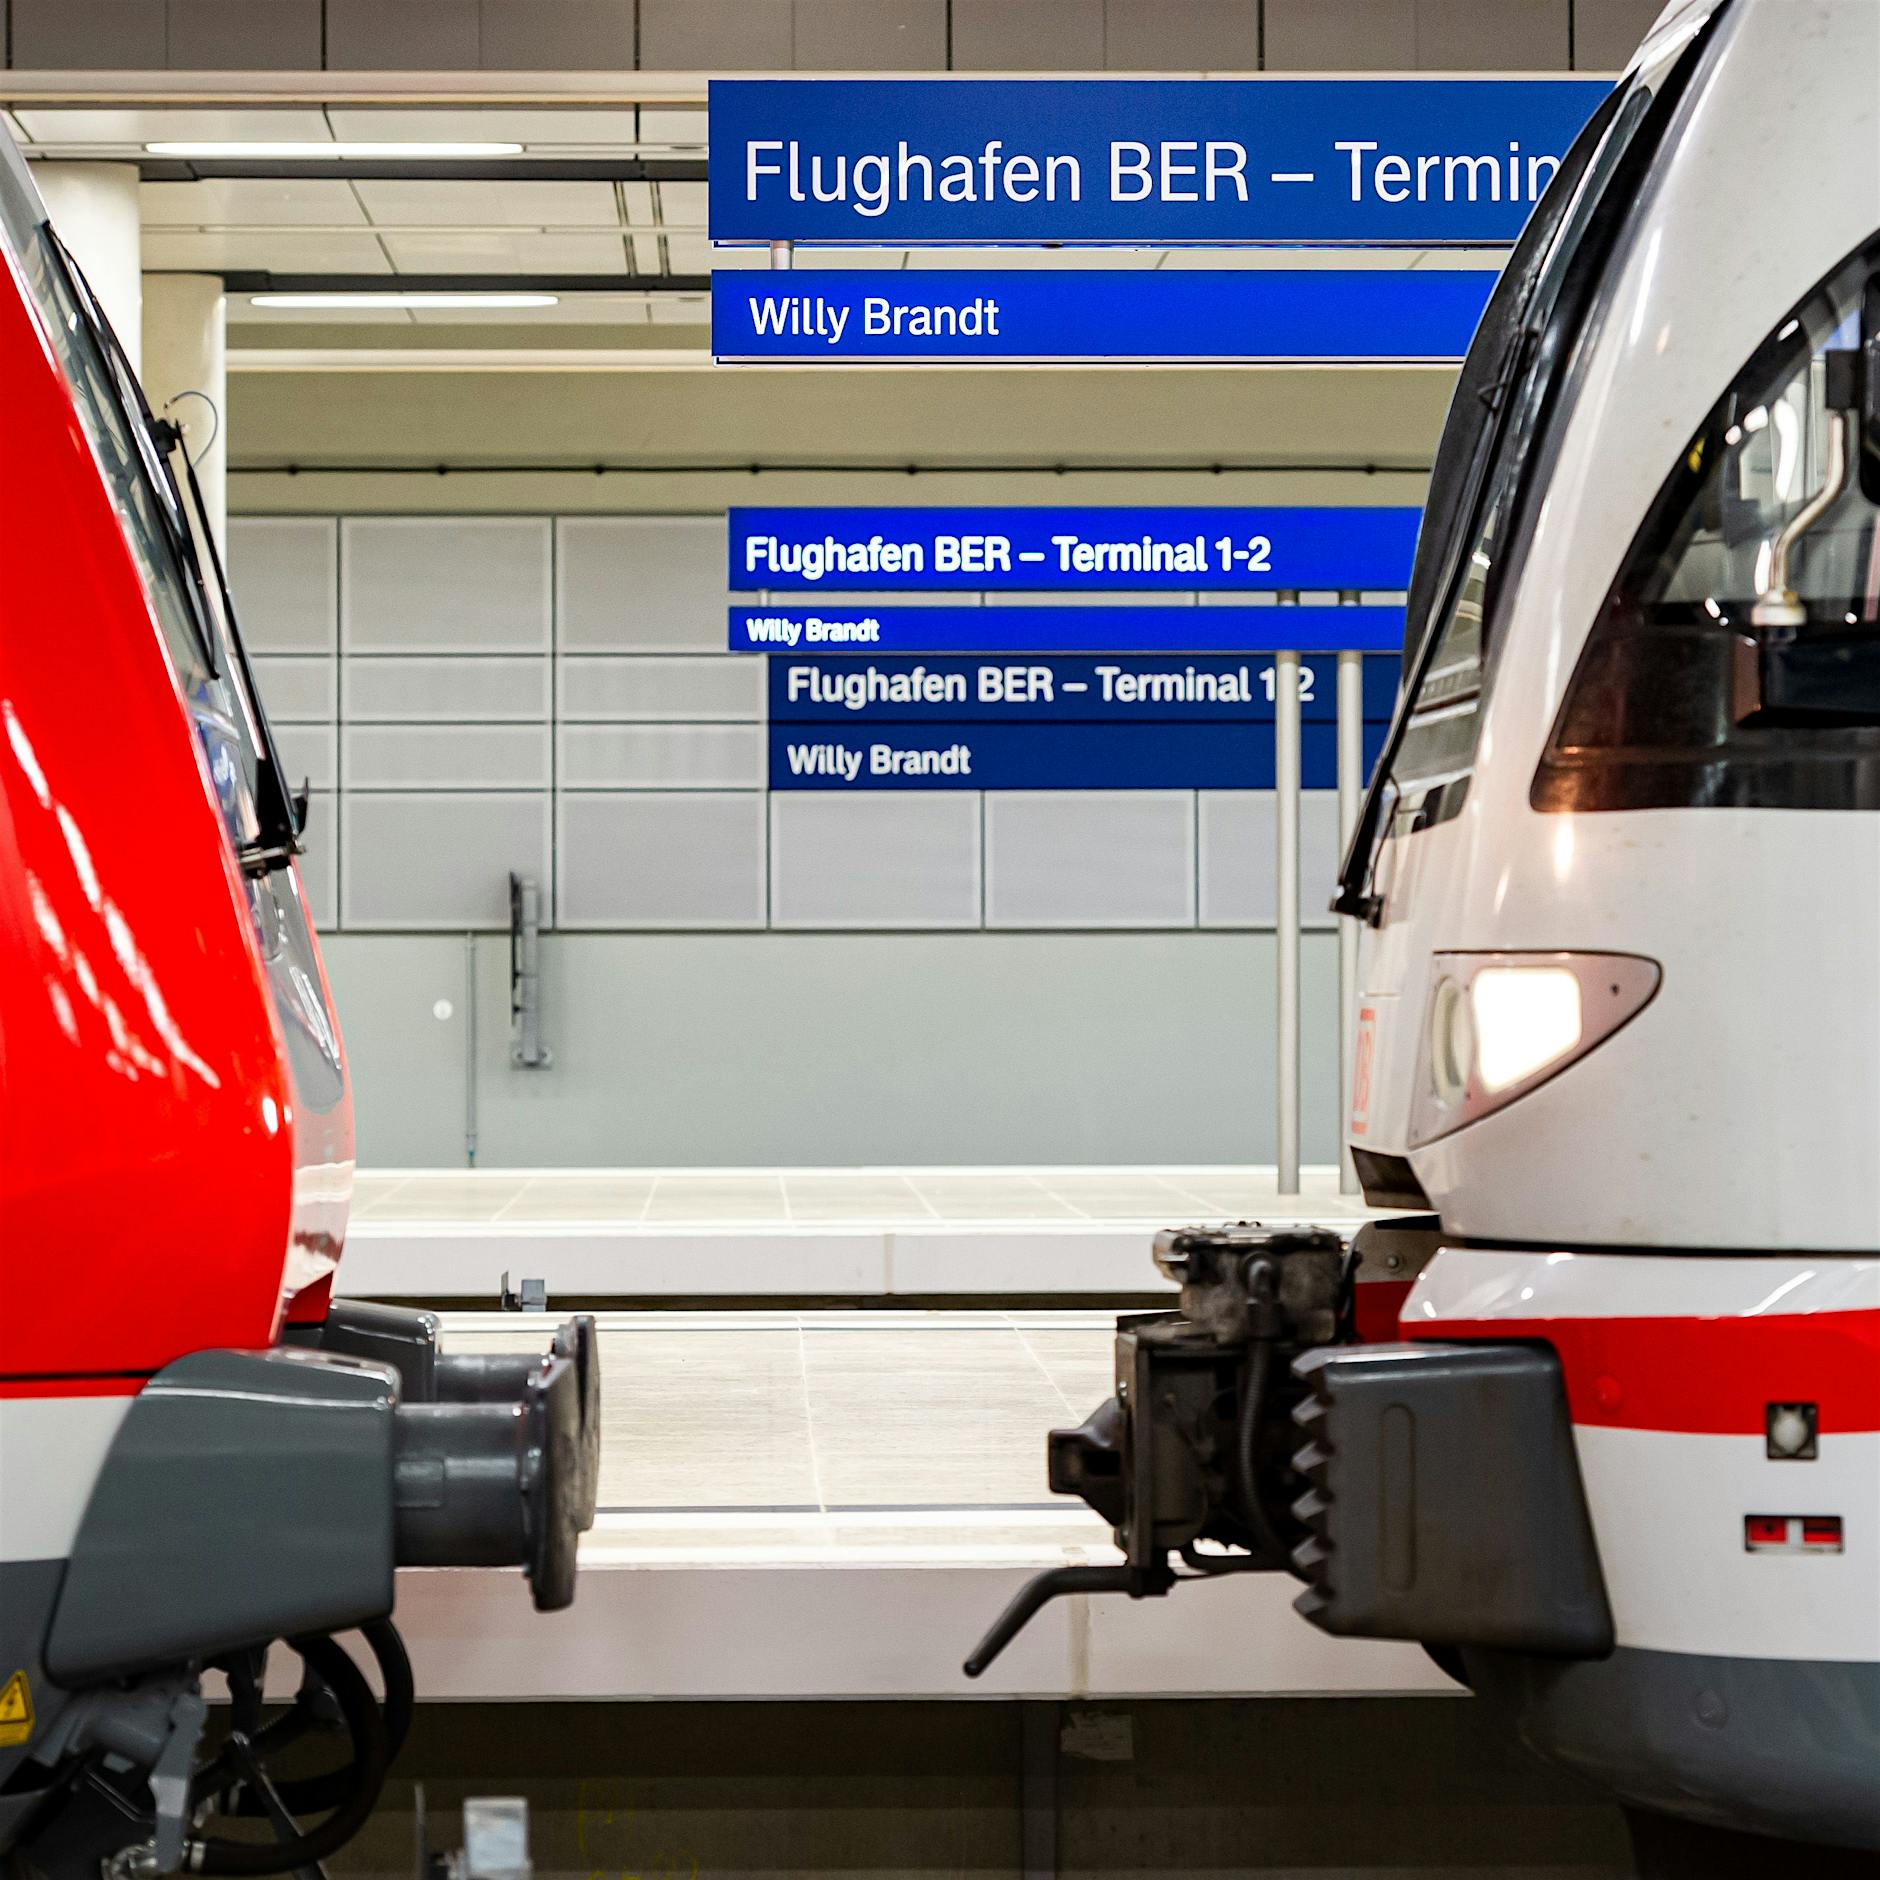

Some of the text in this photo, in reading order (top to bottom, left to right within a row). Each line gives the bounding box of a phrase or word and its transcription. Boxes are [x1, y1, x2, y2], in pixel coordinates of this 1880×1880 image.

[747, 140, 1080, 217] Flughafen
[1110, 141, 1249, 202] BER
[1334, 141, 1561, 203] Termin
[748, 297, 1000, 344] Willy Brandt
[746, 535, 924, 581] Flughafen
[934, 535, 1012, 572] BER
[1051, 535, 1209, 573] Terminal
[1214, 535, 1272, 572] 1-2
[746, 617, 880, 646] Willy Brandt
[788, 666, 967, 710] Flughafen
[977, 666, 1054, 702] BER
[1094, 666, 1252, 703] Terminal
[1259, 666, 1315, 702] 12
[787, 744, 972, 782] Willy Brandt
